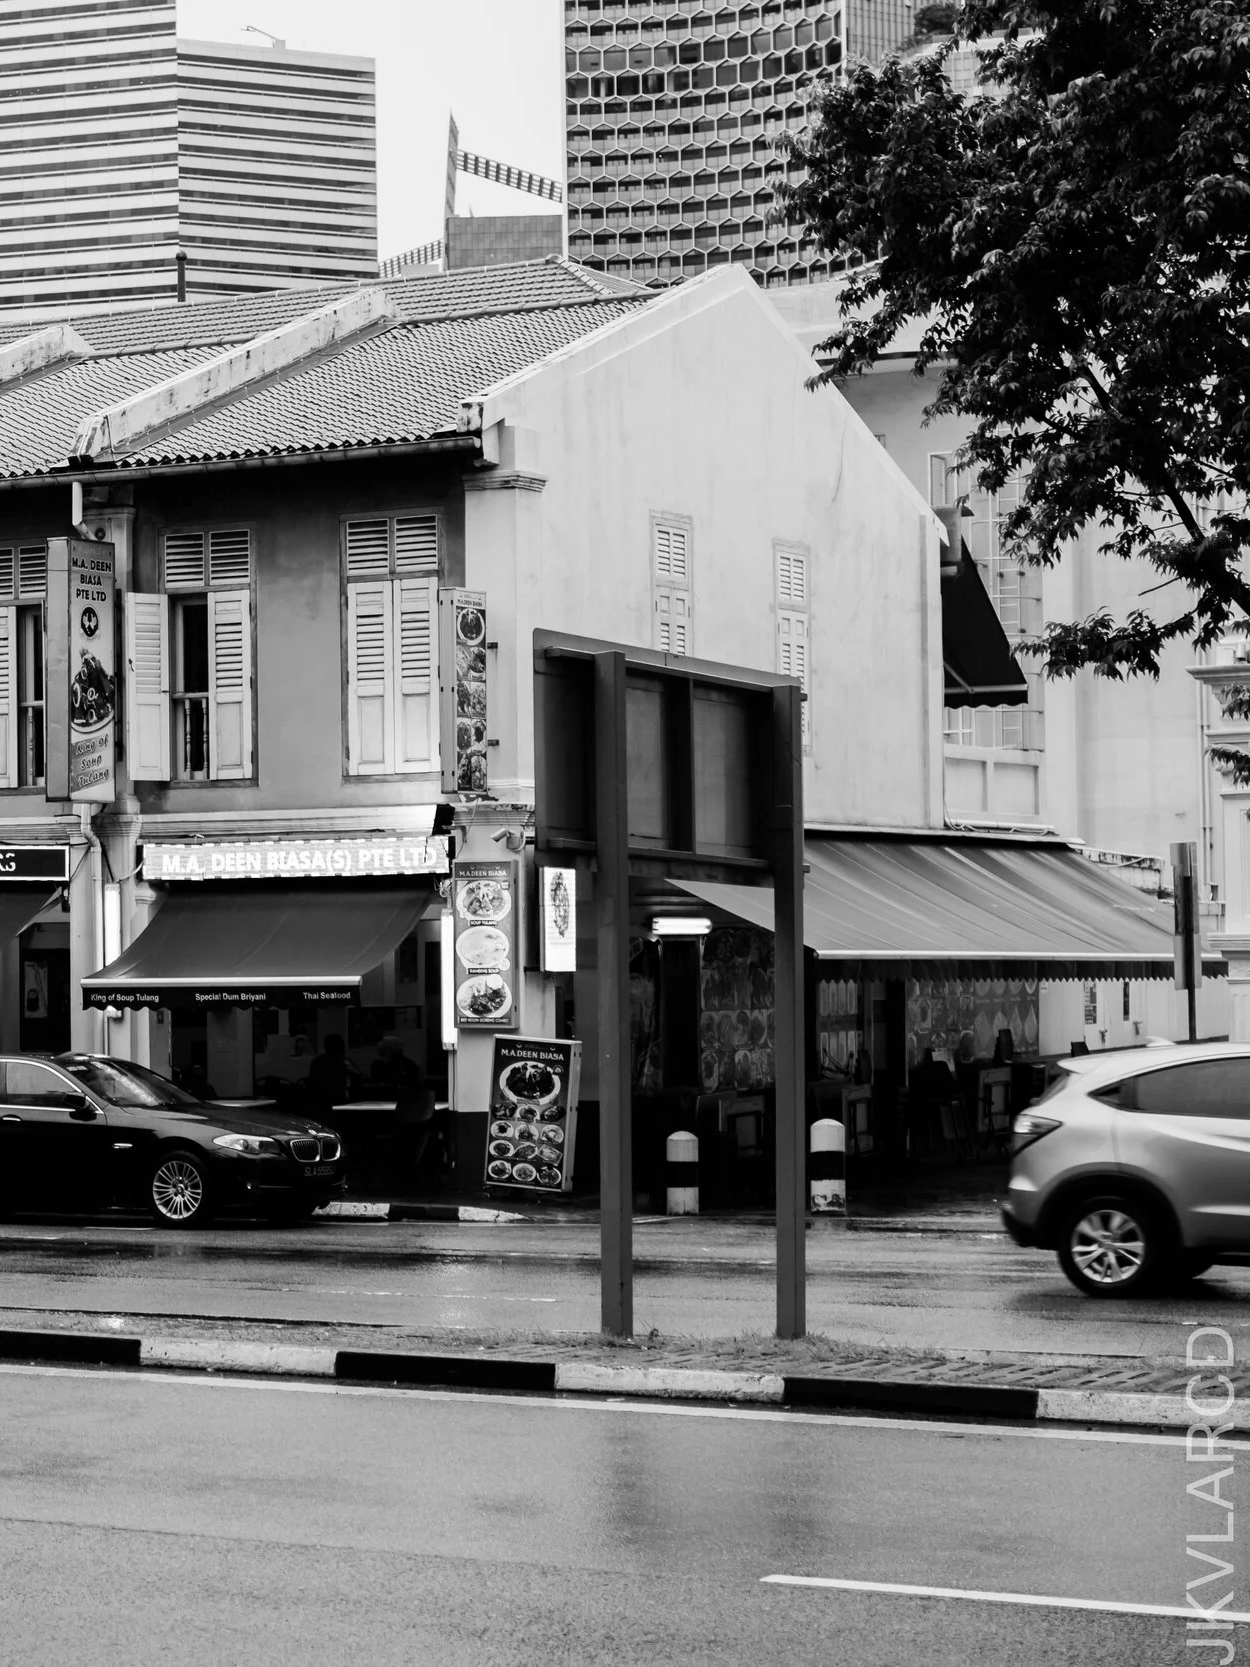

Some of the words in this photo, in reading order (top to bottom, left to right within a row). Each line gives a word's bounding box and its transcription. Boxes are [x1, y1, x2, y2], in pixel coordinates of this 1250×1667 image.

[90, 560, 111, 572] DEEN
[80, 574, 102, 586] BIASA
[76, 588, 89, 600] PTE
[91, 591, 106, 602] LTD
[211, 852, 261, 872] DEEN
[358, 848, 395, 866] PTE
[399, 847, 437, 865] LTD
[91, 993, 107, 1003] King
[108, 993, 115, 1001] of
[116, 993, 135, 1003] Soup
[136, 993, 159, 1003] Tulang
[241, 992, 266, 1002] Briyani
[320, 991, 351, 999] Seafood
[540, 1051, 564, 1061] BIASA
